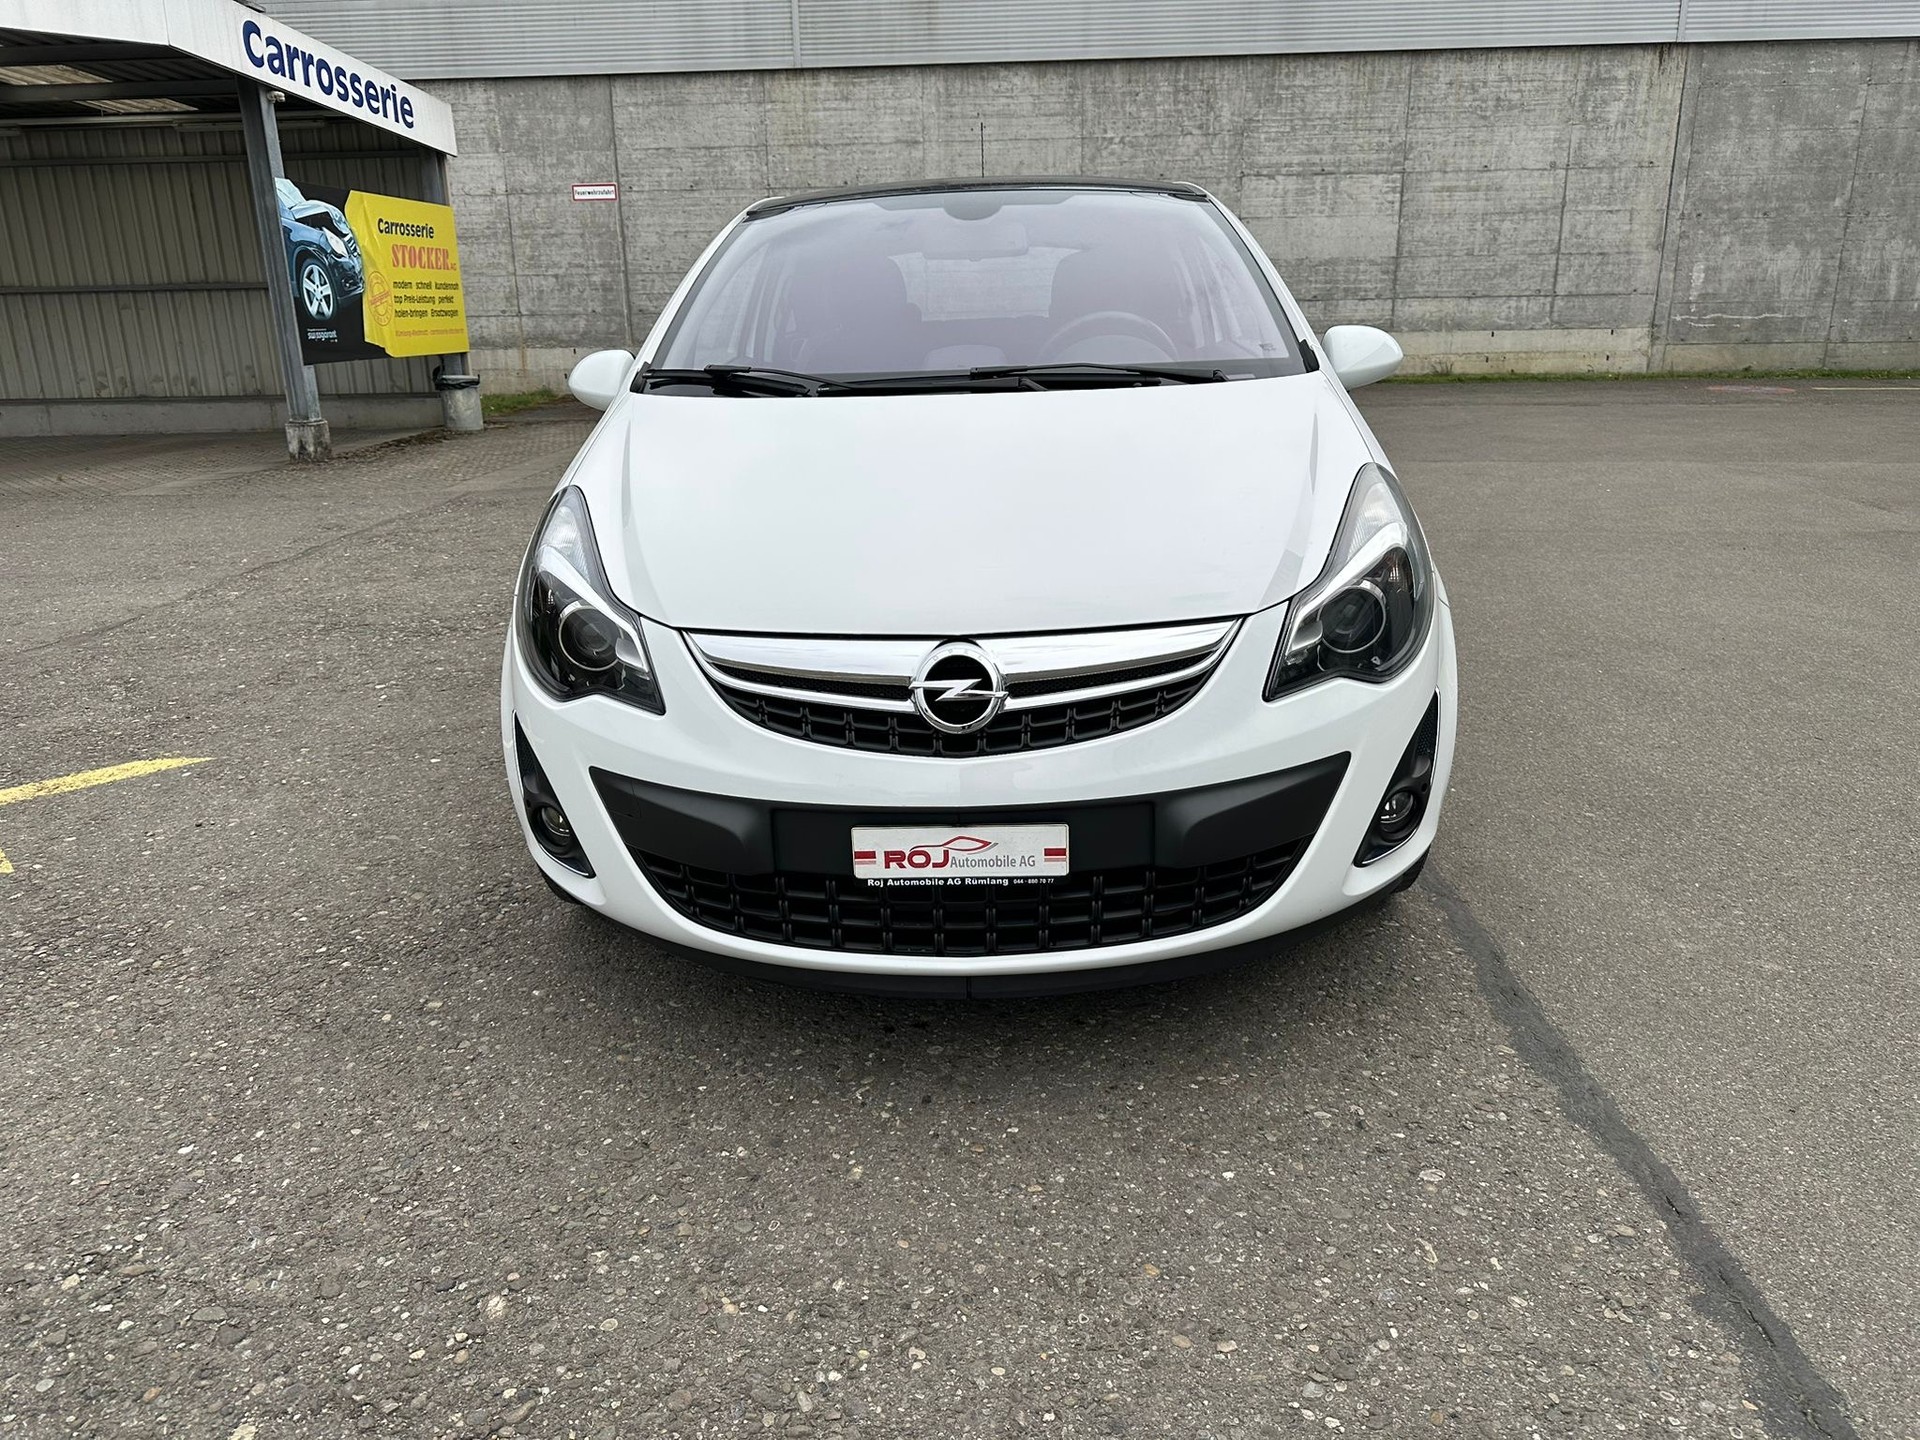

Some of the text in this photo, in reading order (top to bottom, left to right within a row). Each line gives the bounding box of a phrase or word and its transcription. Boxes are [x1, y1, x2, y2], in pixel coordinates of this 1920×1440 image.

[242, 20, 415, 129] Carrosserie
[378, 218, 435, 239] Carrosserie
[391, 244, 450, 271] STOCKER
[393, 281, 412, 289] modern
[415, 281, 432, 290] schnell
[394, 295, 403, 305] top
[884, 849, 1036, 869] ROJ Automobile AG
[867, 878, 884, 887] Roj
[887, 878, 944, 886] Automobile
[947, 878, 962, 886] AG
[965, 877, 1009, 887] Rümlang
